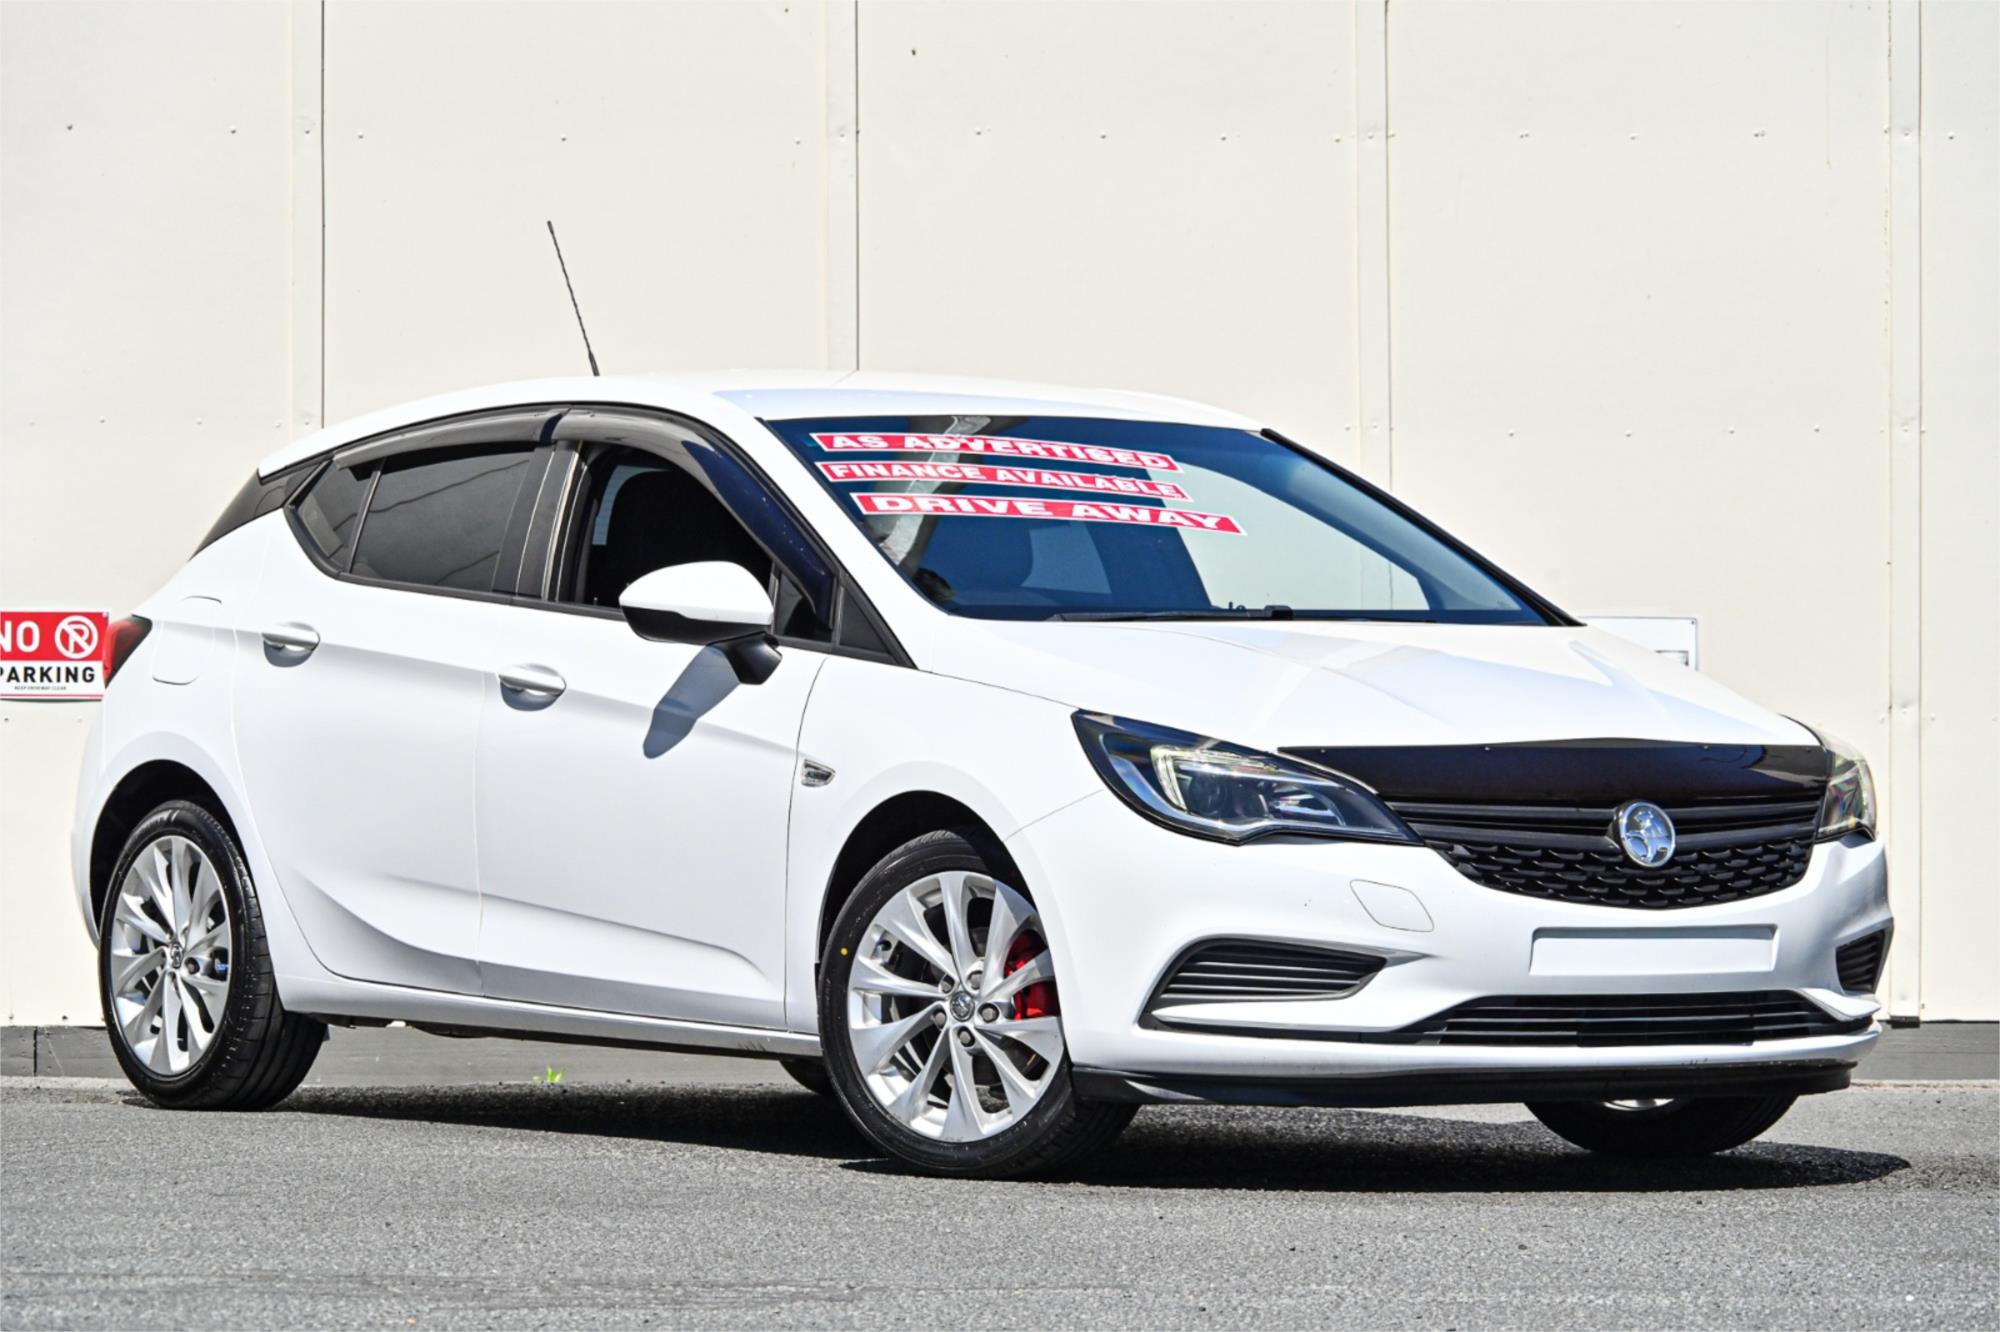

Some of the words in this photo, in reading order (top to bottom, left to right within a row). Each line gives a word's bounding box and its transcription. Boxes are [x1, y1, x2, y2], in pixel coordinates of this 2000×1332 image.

[832, 435, 889, 449] AS
[904, 436, 1169, 468] ADVERTISED
[828, 463, 986, 480] FINANCE
[996, 468, 1180, 496] AVAILABLE
[870, 496, 1053, 516] DRIVE
[1072, 504, 1225, 529] AWAY
